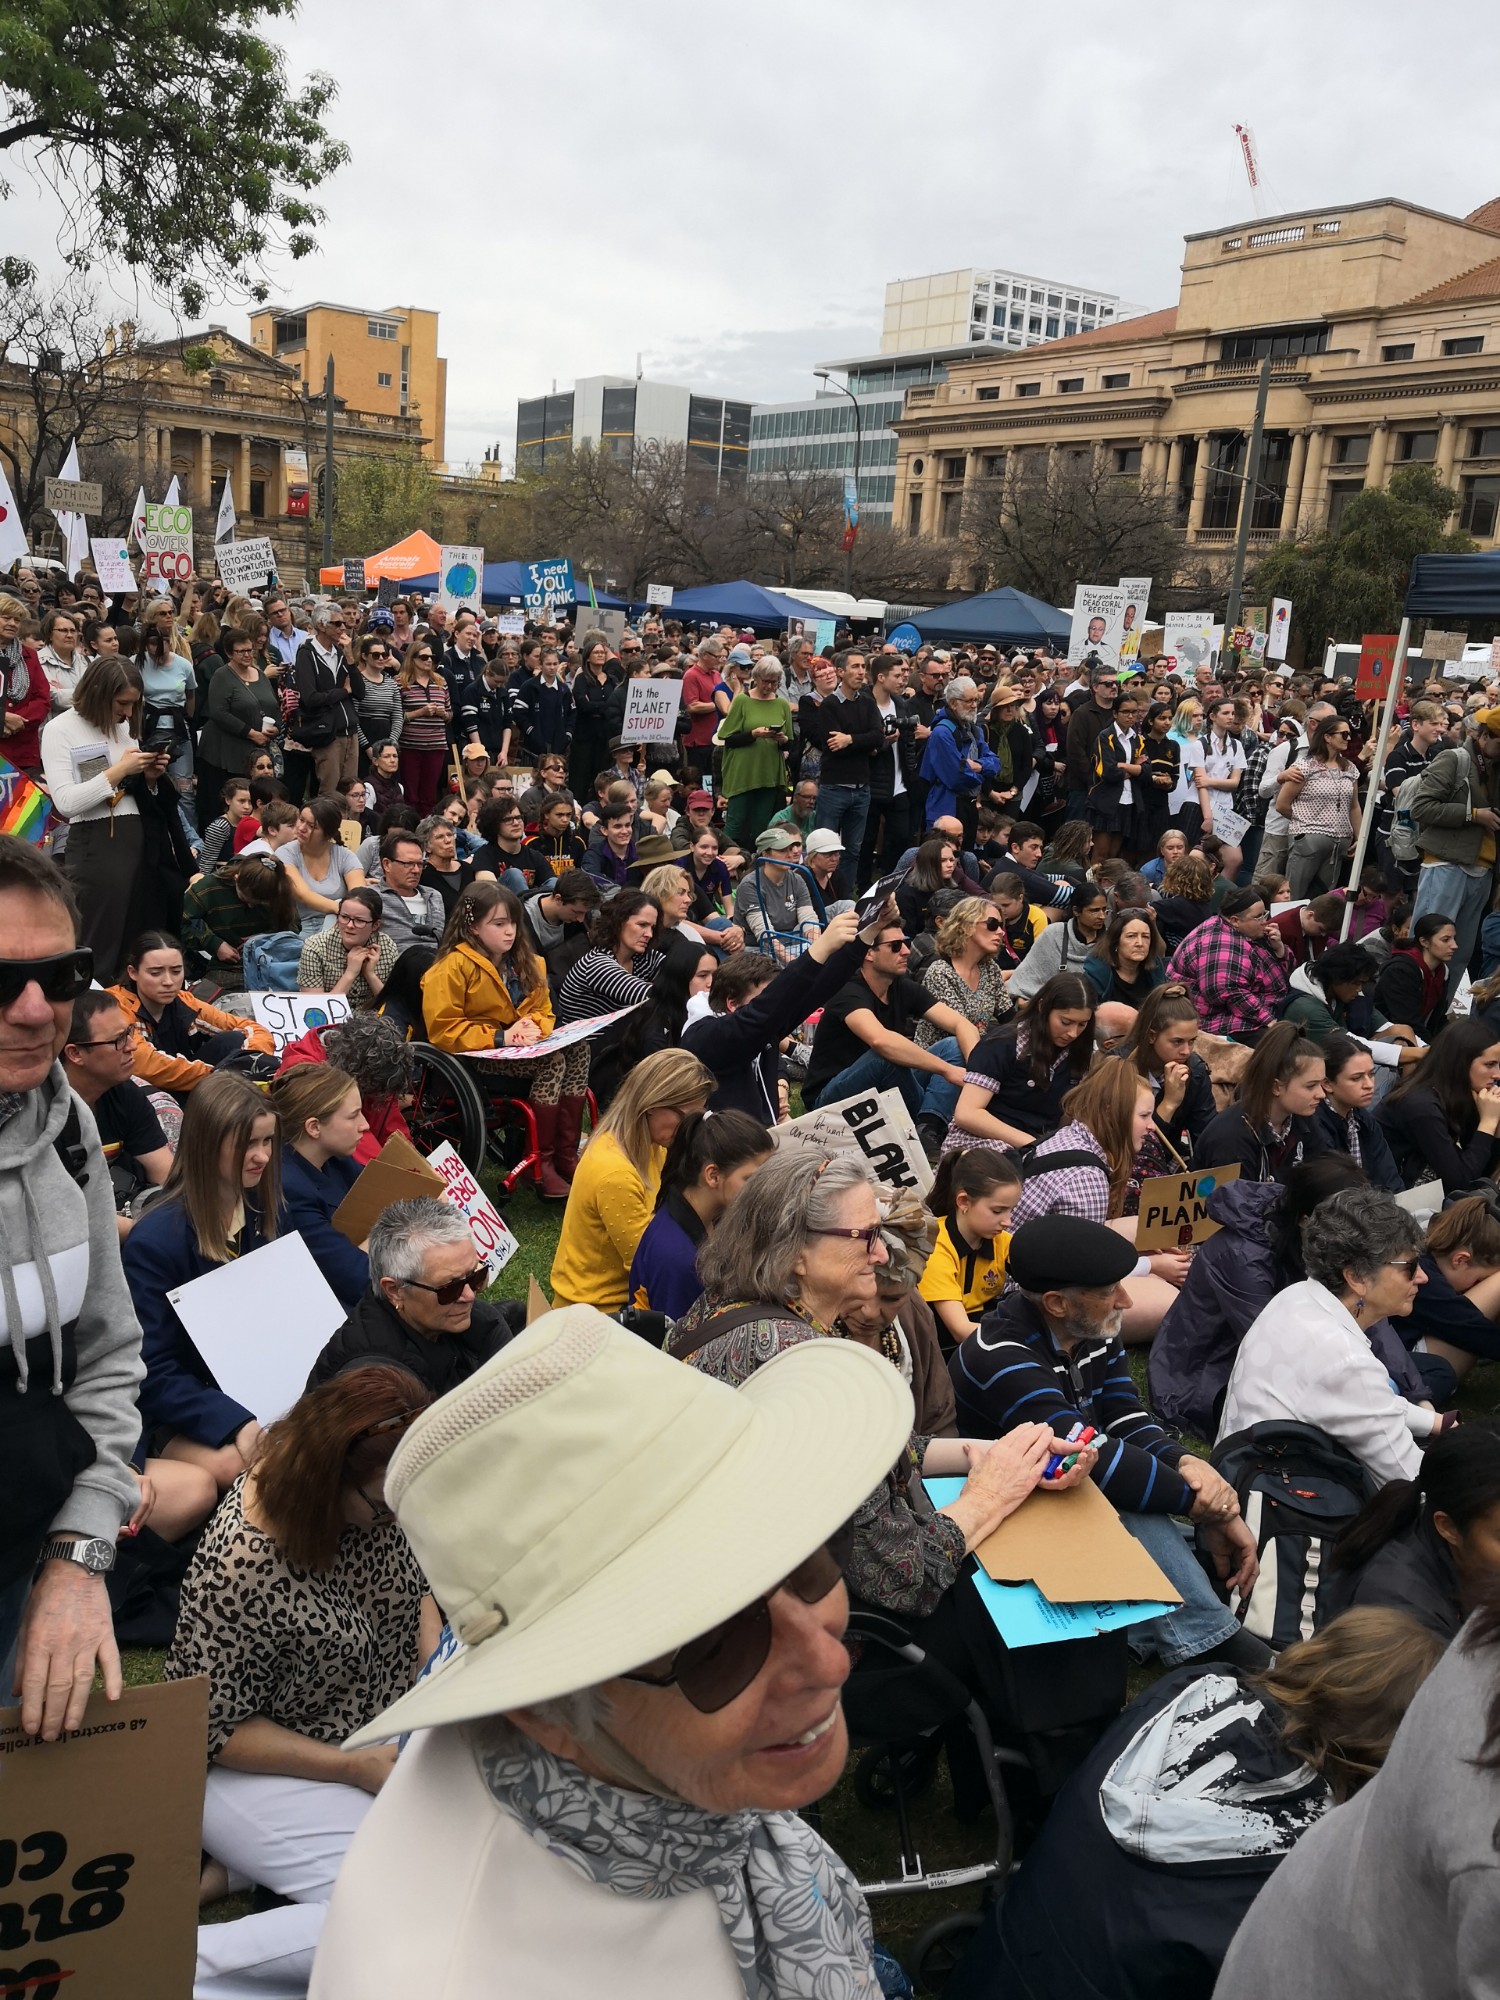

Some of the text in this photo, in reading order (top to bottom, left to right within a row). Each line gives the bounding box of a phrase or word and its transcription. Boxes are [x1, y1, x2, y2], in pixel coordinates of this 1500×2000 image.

[48, 488, 98, 502] NOTHING
[146, 504, 192, 534] ECO
[147, 534, 189, 552] OVER
[218, 541, 270, 558] WHY SHOULD WE
[241, 552, 264, 563] SCHOOL
[266, 550, 272, 558] IF
[146, 551, 192, 580] EGO
[222, 568, 236, 578] YOU
[254, 559, 274, 570] LISTEN
[528, 560, 568, 580] I need
[224, 577, 236, 586] TO
[238, 573, 250, 582] THE
[451, 591, 477, 600] PLANET
[524, 588, 574, 606] TO PANIC
[1102, 600, 1122, 608] CORAL
[646, 688, 660, 698] the
[630, 702, 672, 714] PLANET
[628, 718, 664, 730] STUPID
[842, 1098, 918, 1188] BLAH
[1178, 1224, 1193, 1245] B
[71, 1721, 126, 1738] exxxtra
[130, 1718, 147, 1730] 48
